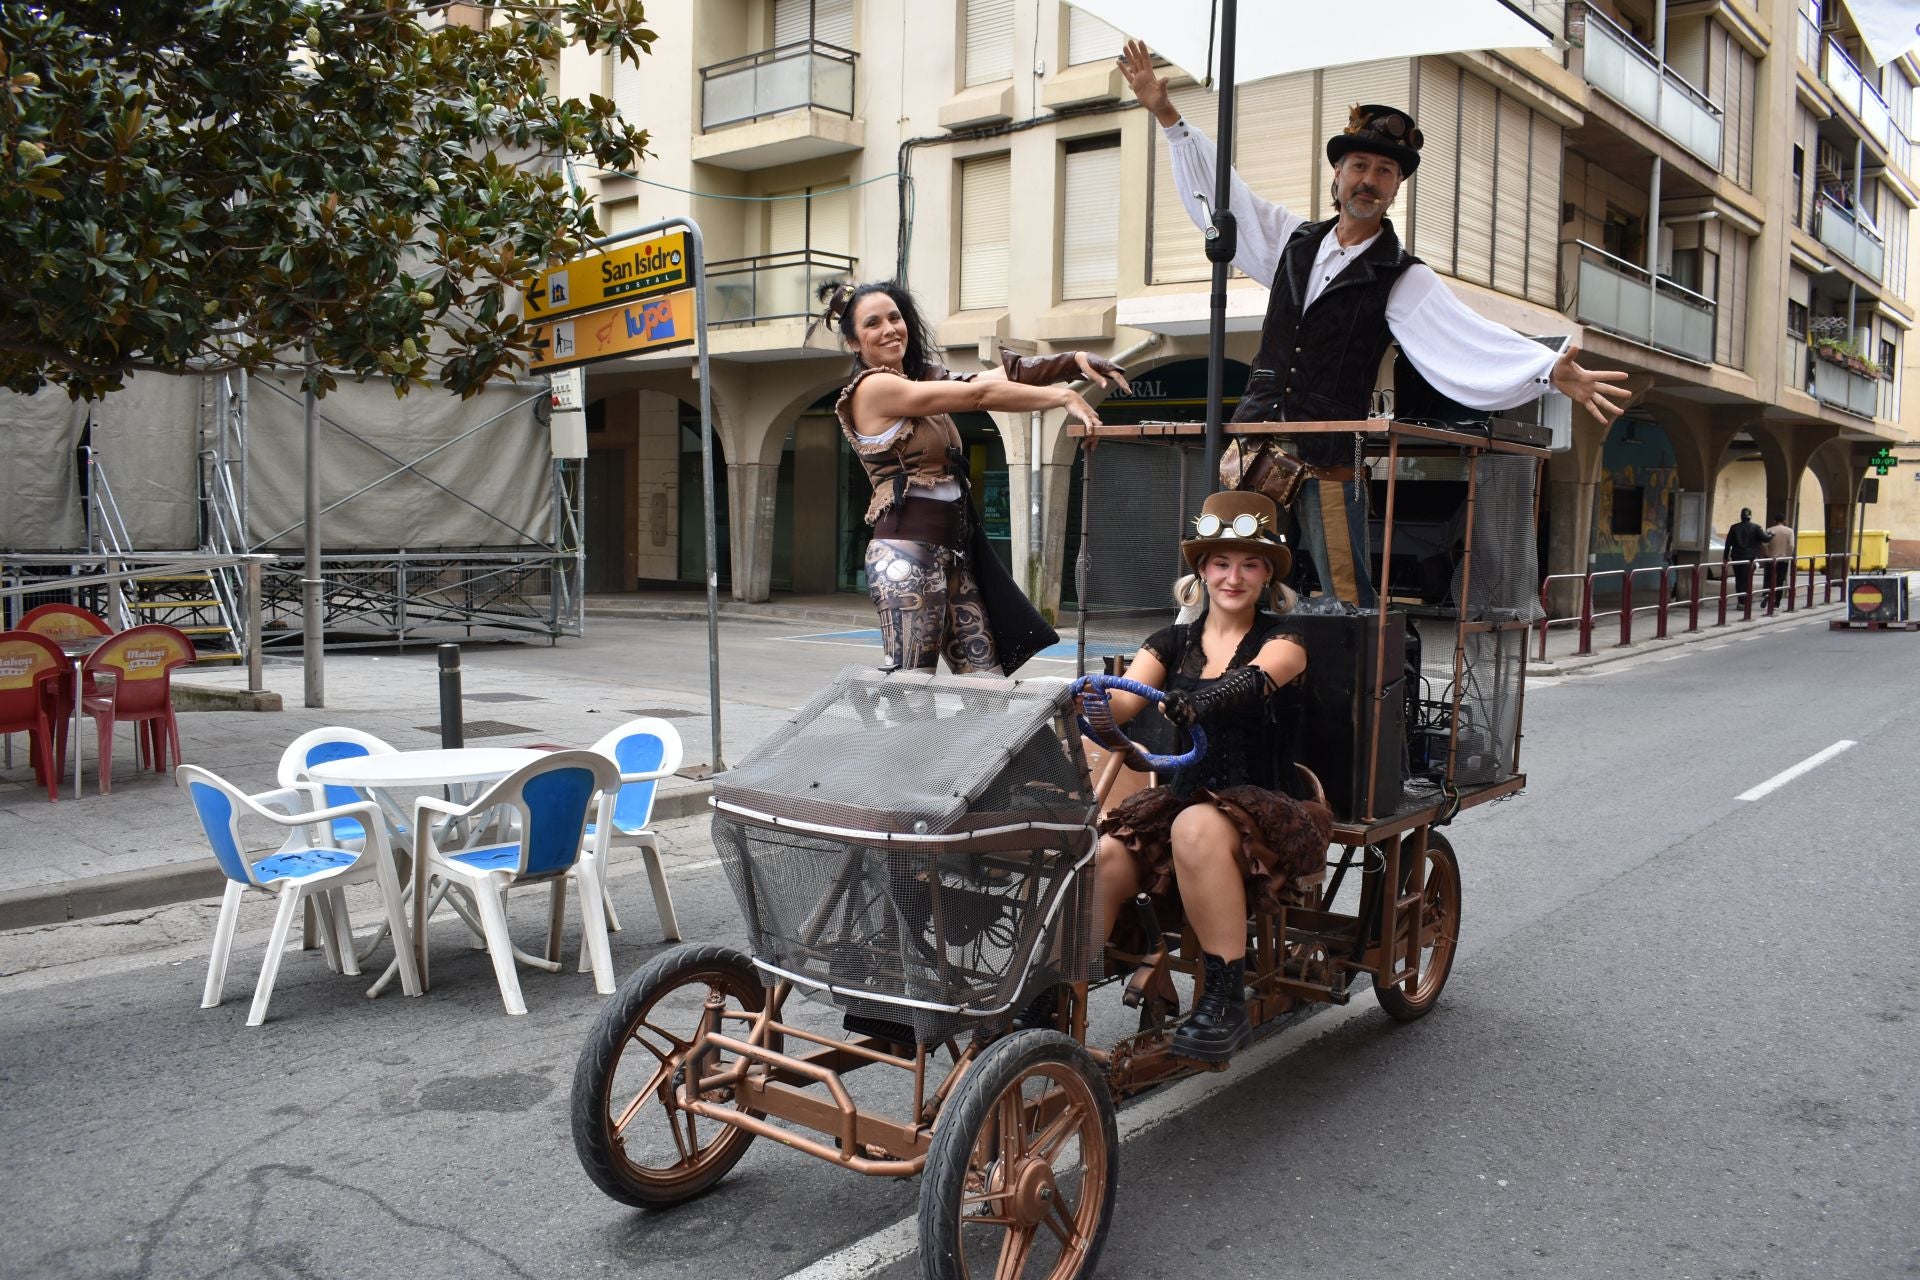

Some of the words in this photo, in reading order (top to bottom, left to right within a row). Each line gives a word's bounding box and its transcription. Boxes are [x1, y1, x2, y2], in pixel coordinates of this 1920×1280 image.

[602, 260, 632, 283] San
[635, 245, 681, 275] Isidro
[615, 274, 669, 293] HOSTAL
[624, 300, 673, 341] lupa
[127, 649, 165, 659] Mahou
